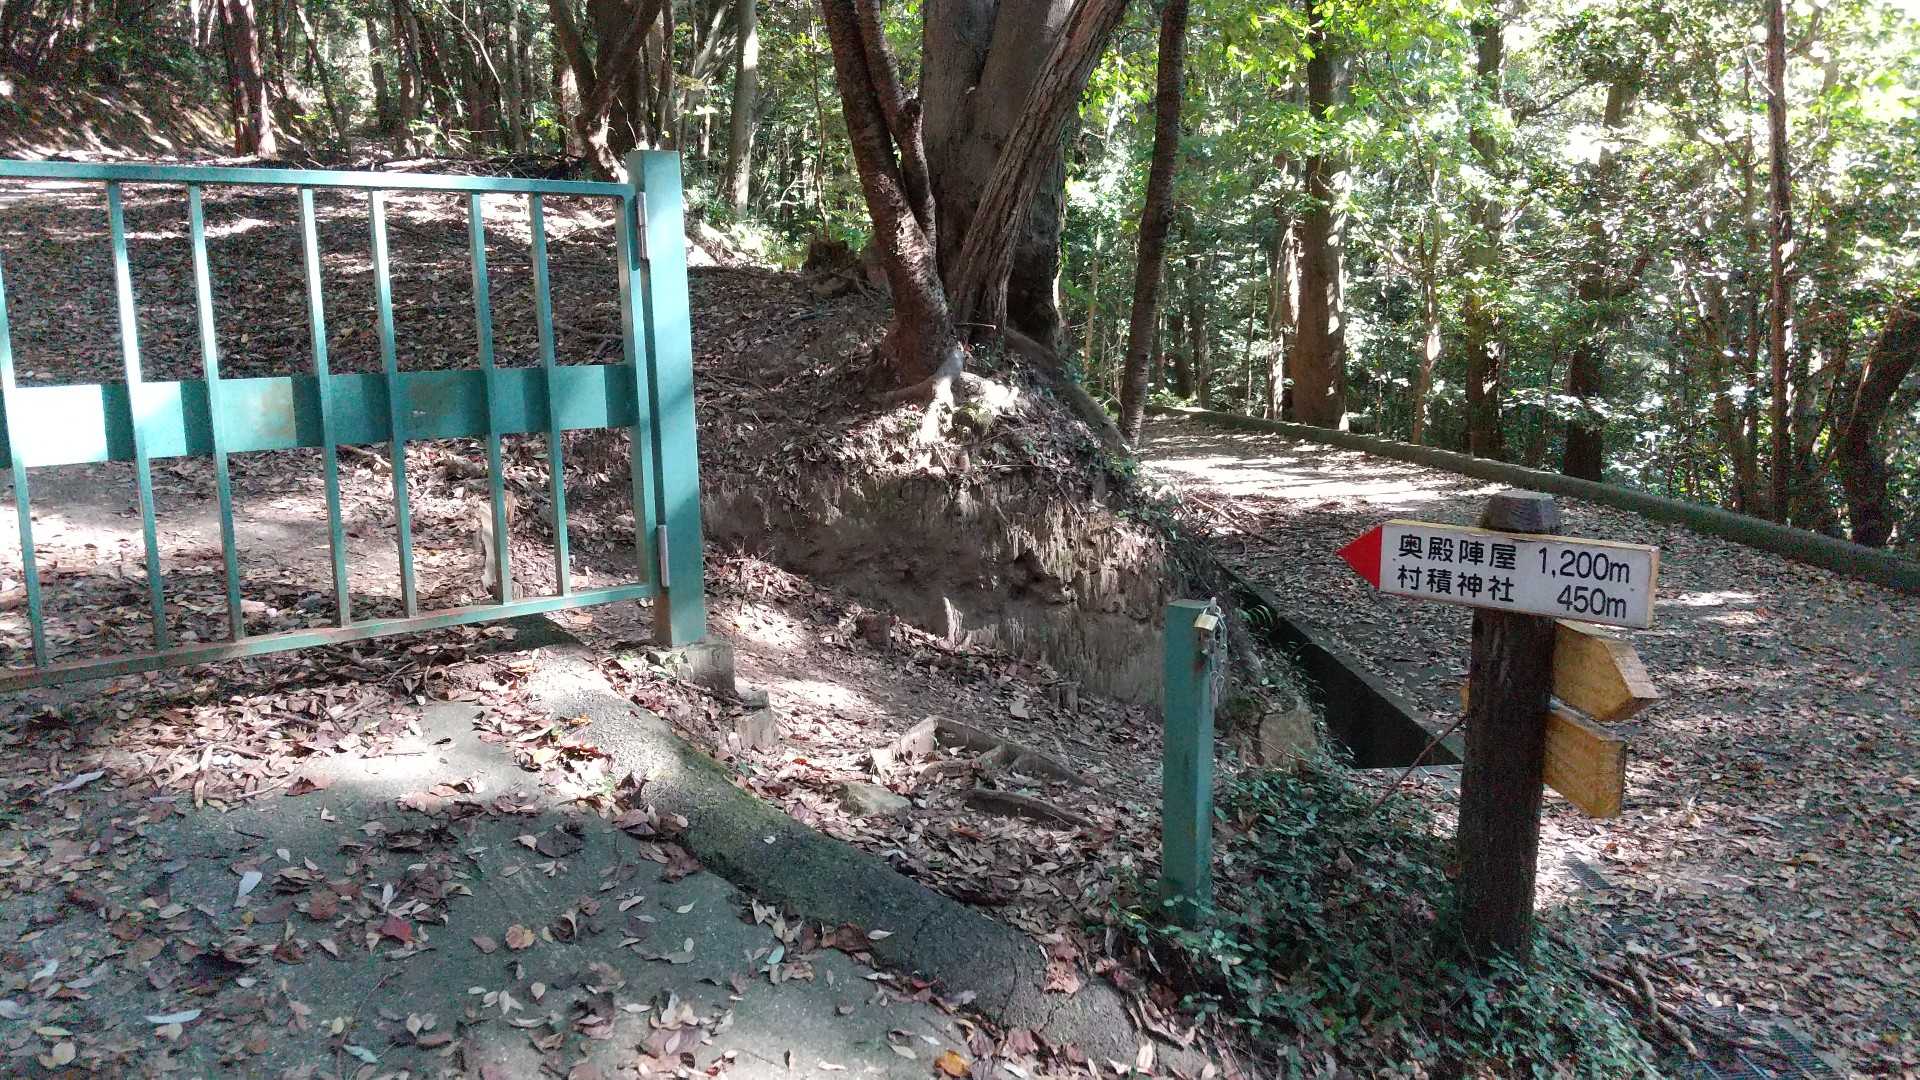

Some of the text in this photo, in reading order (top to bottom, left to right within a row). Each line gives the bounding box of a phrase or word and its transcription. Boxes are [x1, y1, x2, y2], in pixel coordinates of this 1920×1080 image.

[1398, 534, 1630, 583] 奥殿陣屋 1,200m
[1397, 565, 1626, 618] 村積神社 450m
